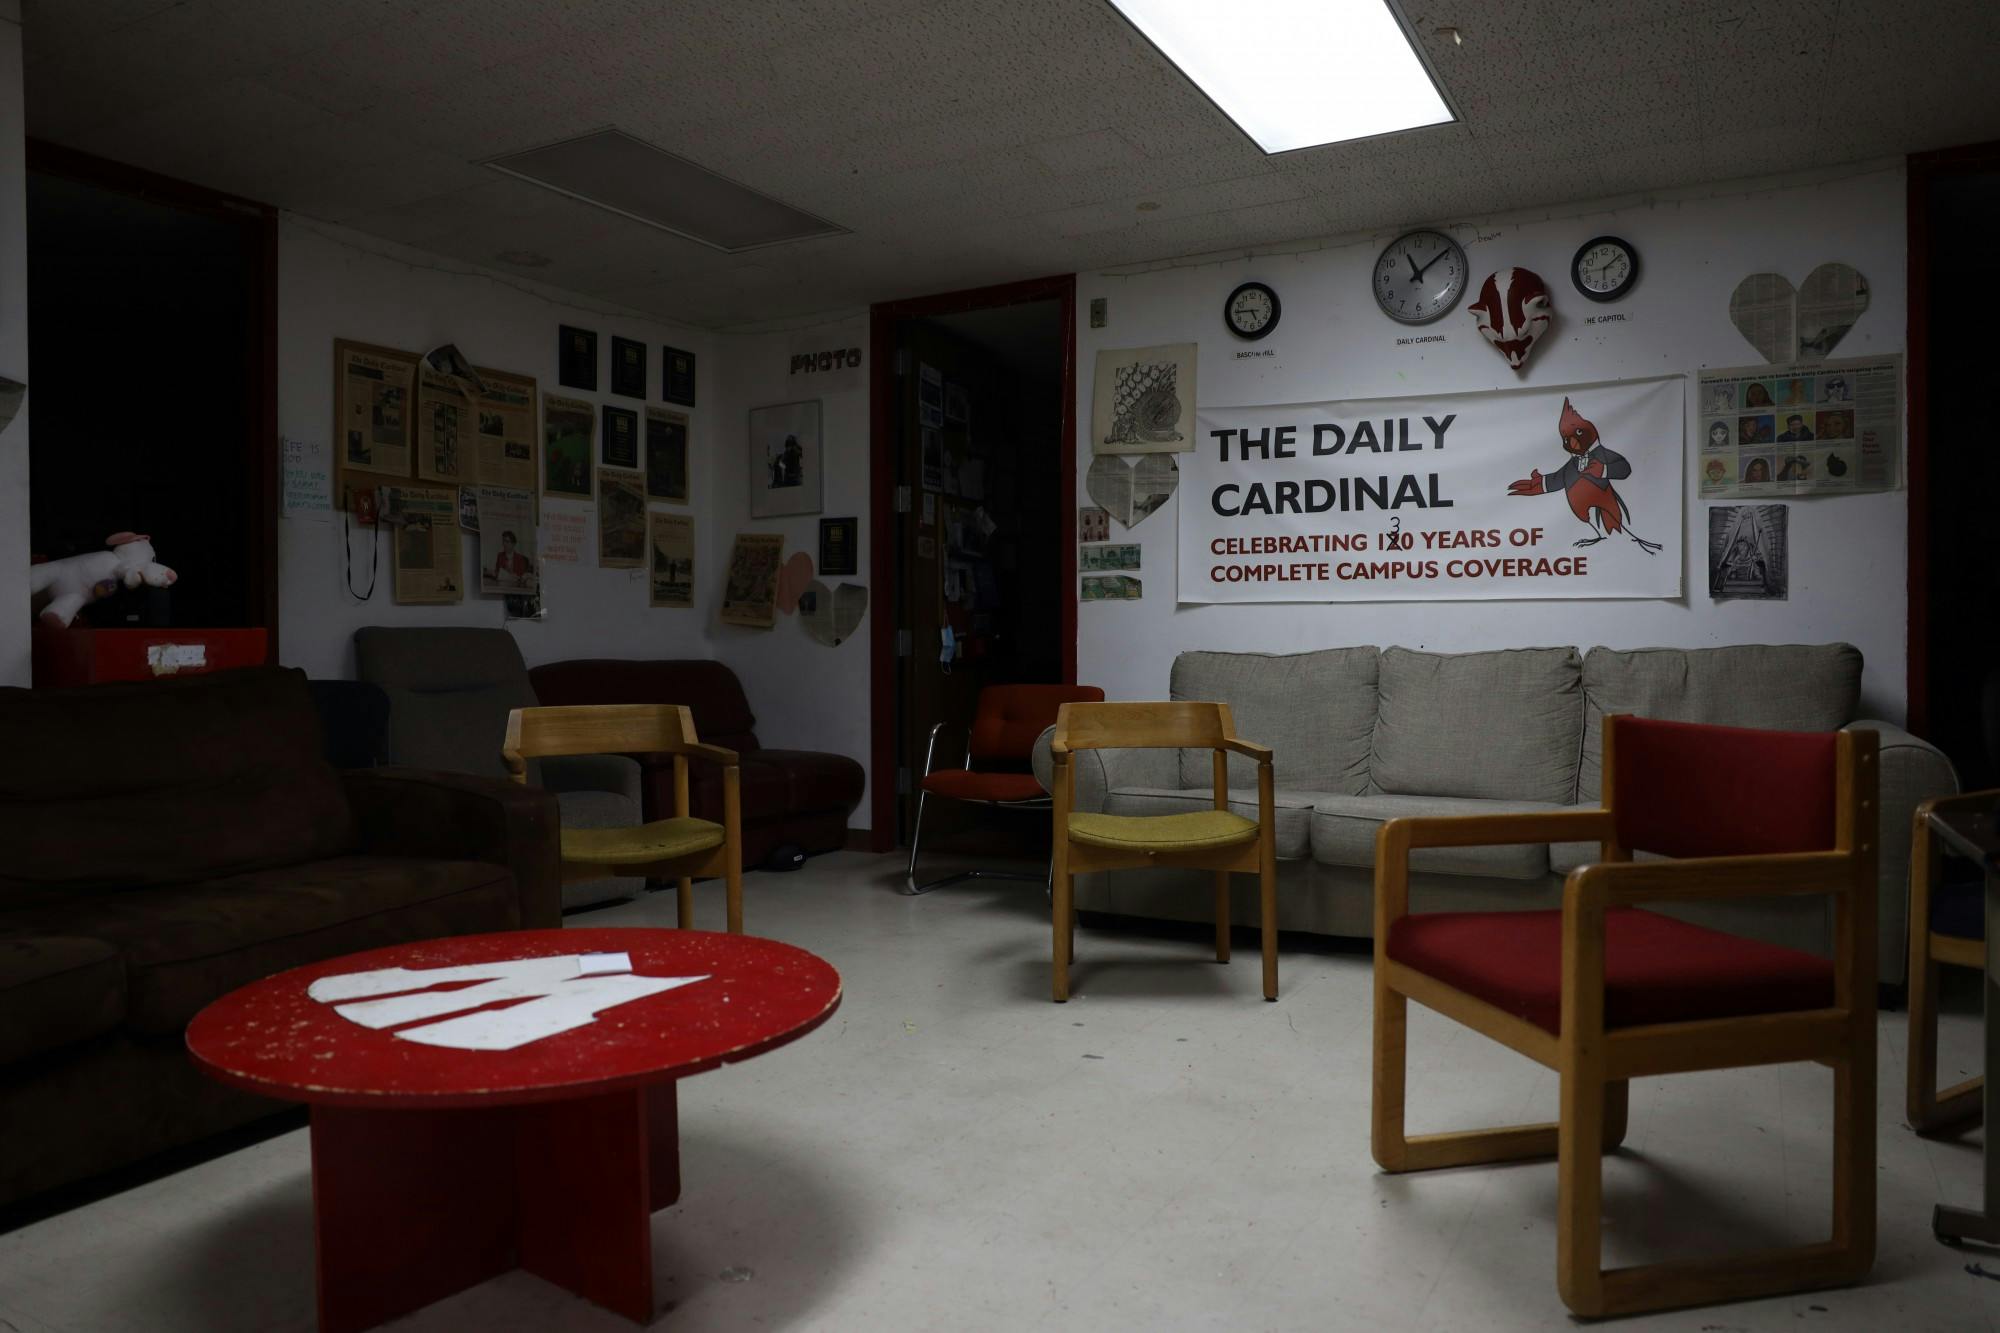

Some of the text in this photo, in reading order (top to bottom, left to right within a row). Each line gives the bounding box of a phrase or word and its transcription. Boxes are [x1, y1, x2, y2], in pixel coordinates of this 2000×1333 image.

[1598, 314, 1626, 323] CAPITOL
[1396, 335, 1446, 345] DAILY CARDINAL
[790, 347, 862, 375] PHOTO
[1210, 414, 1457, 462] THE DAILY
[1211, 473, 1454, 517] CARDINAL
[1390, 516, 1401, 533] 3
[1210, 533, 1368, 555] CELEBRATING
[1421, 529, 1501, 549] YEARS
[1509, 528, 1544, 547] OF
[1210, 557, 1588, 582] COMPLETE CAMPUS COVERAGE
